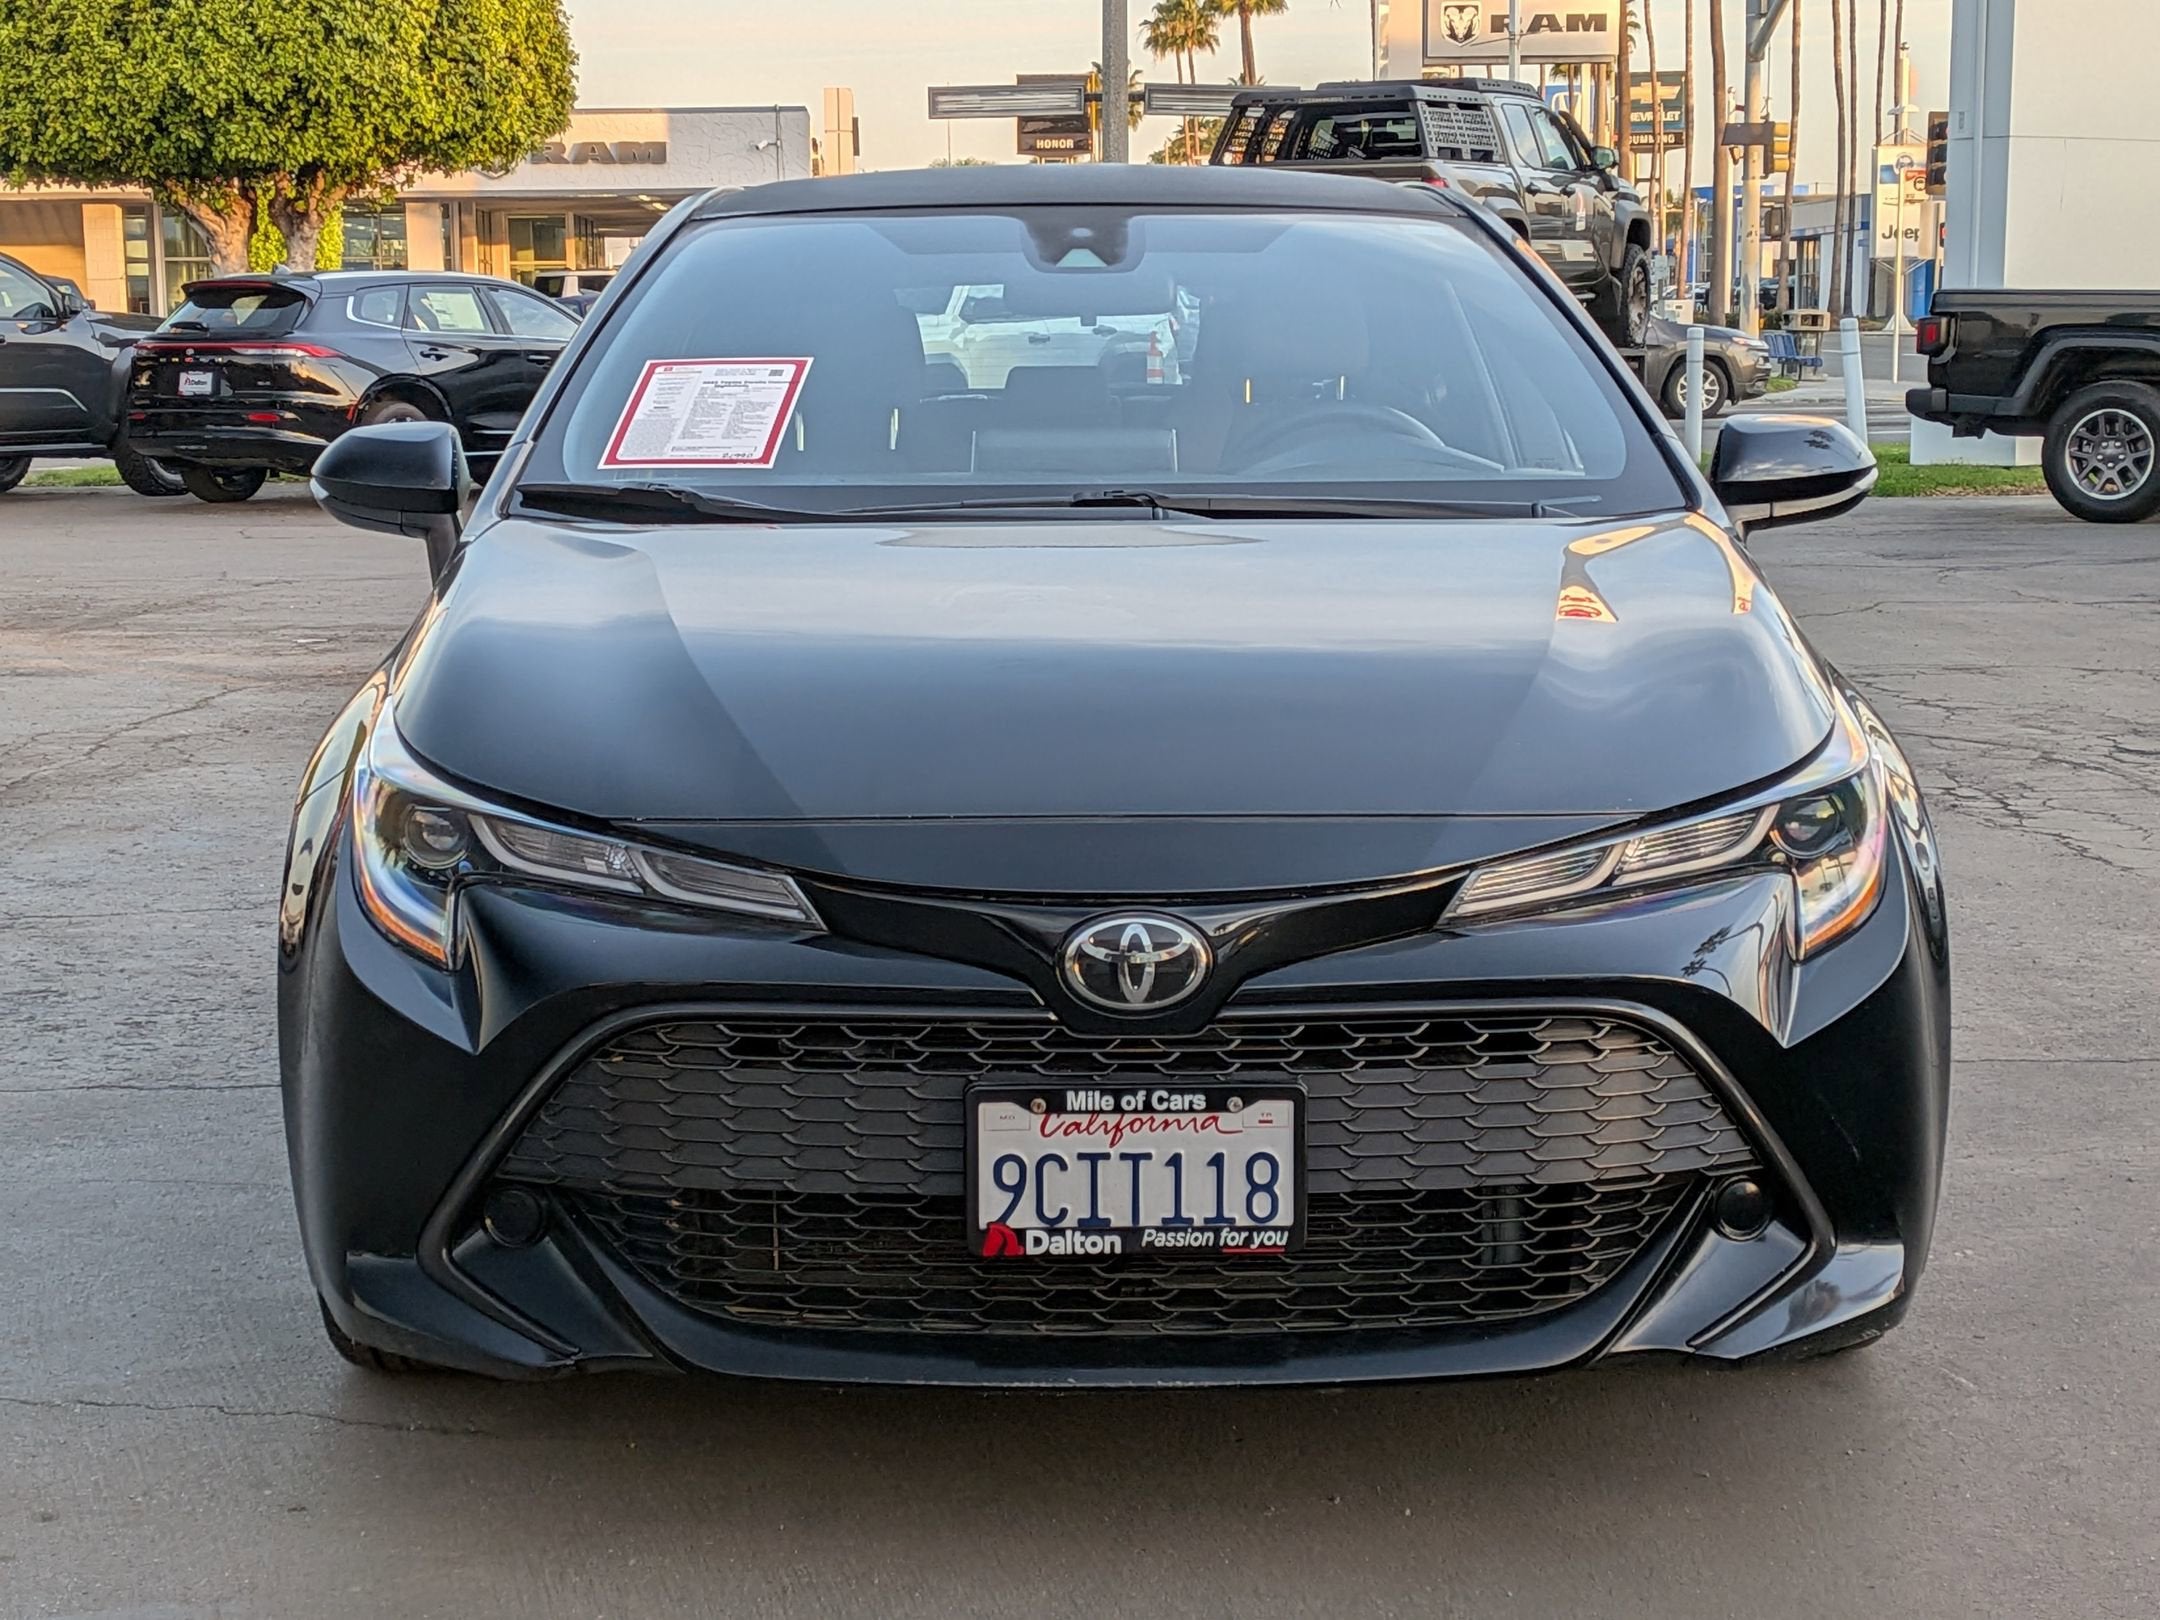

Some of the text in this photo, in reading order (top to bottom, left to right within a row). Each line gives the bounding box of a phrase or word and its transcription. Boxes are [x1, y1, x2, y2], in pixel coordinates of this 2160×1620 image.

[1490, 14, 1607, 33] RAM
[529, 141, 666, 164] RAM
[1036, 139, 1074, 149] HONOR
[1066, 1089, 1207, 1112] Mile of Cars
[1040, 1112, 1244, 1149] California
[993, 1152, 1279, 1228] 9CIT118
[1025, 1229, 1122, 1256] Dalton
[1141, 1227, 1289, 1250] Passion for you
